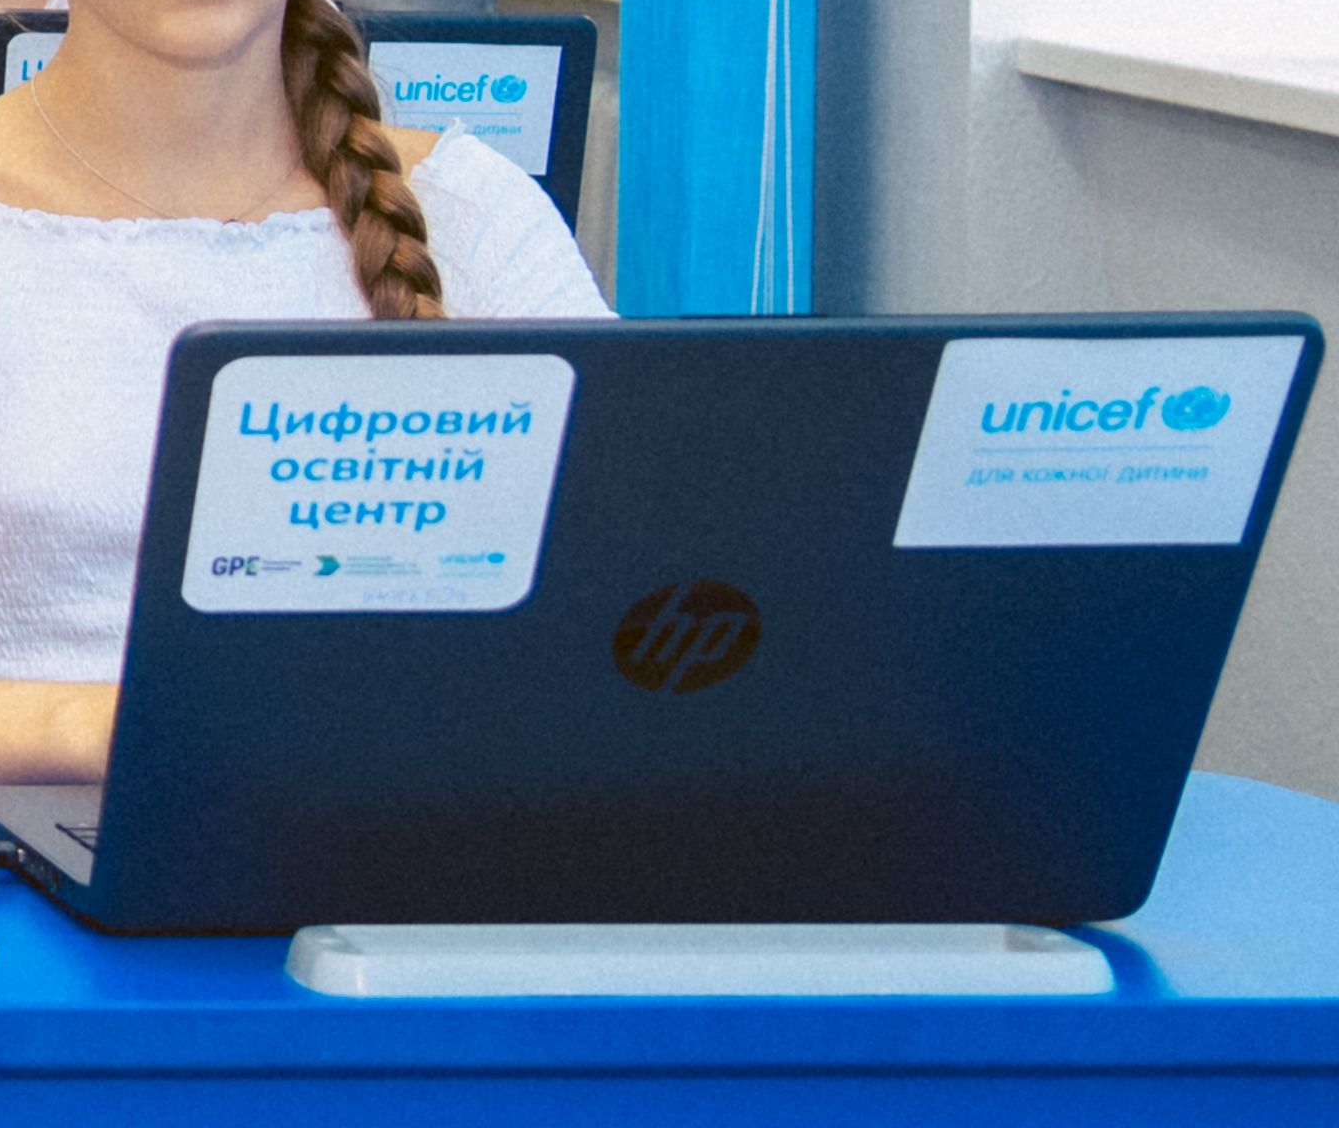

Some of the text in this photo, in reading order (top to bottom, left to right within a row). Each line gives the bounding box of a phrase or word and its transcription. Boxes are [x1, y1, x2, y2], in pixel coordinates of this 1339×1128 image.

[394, 73, 490, 103] unicef
[238, 399, 534, 443] Цифровий
[980, 386, 1161, 435] unicef
[269, 447, 486, 483] освітній
[965, 468, 1016, 488] для
[1116, 465, 1210, 485] дитини
[288, 498, 448, 533] центр
[210, 556, 260, 577] GPE
[627, 582, 750, 695] hp
